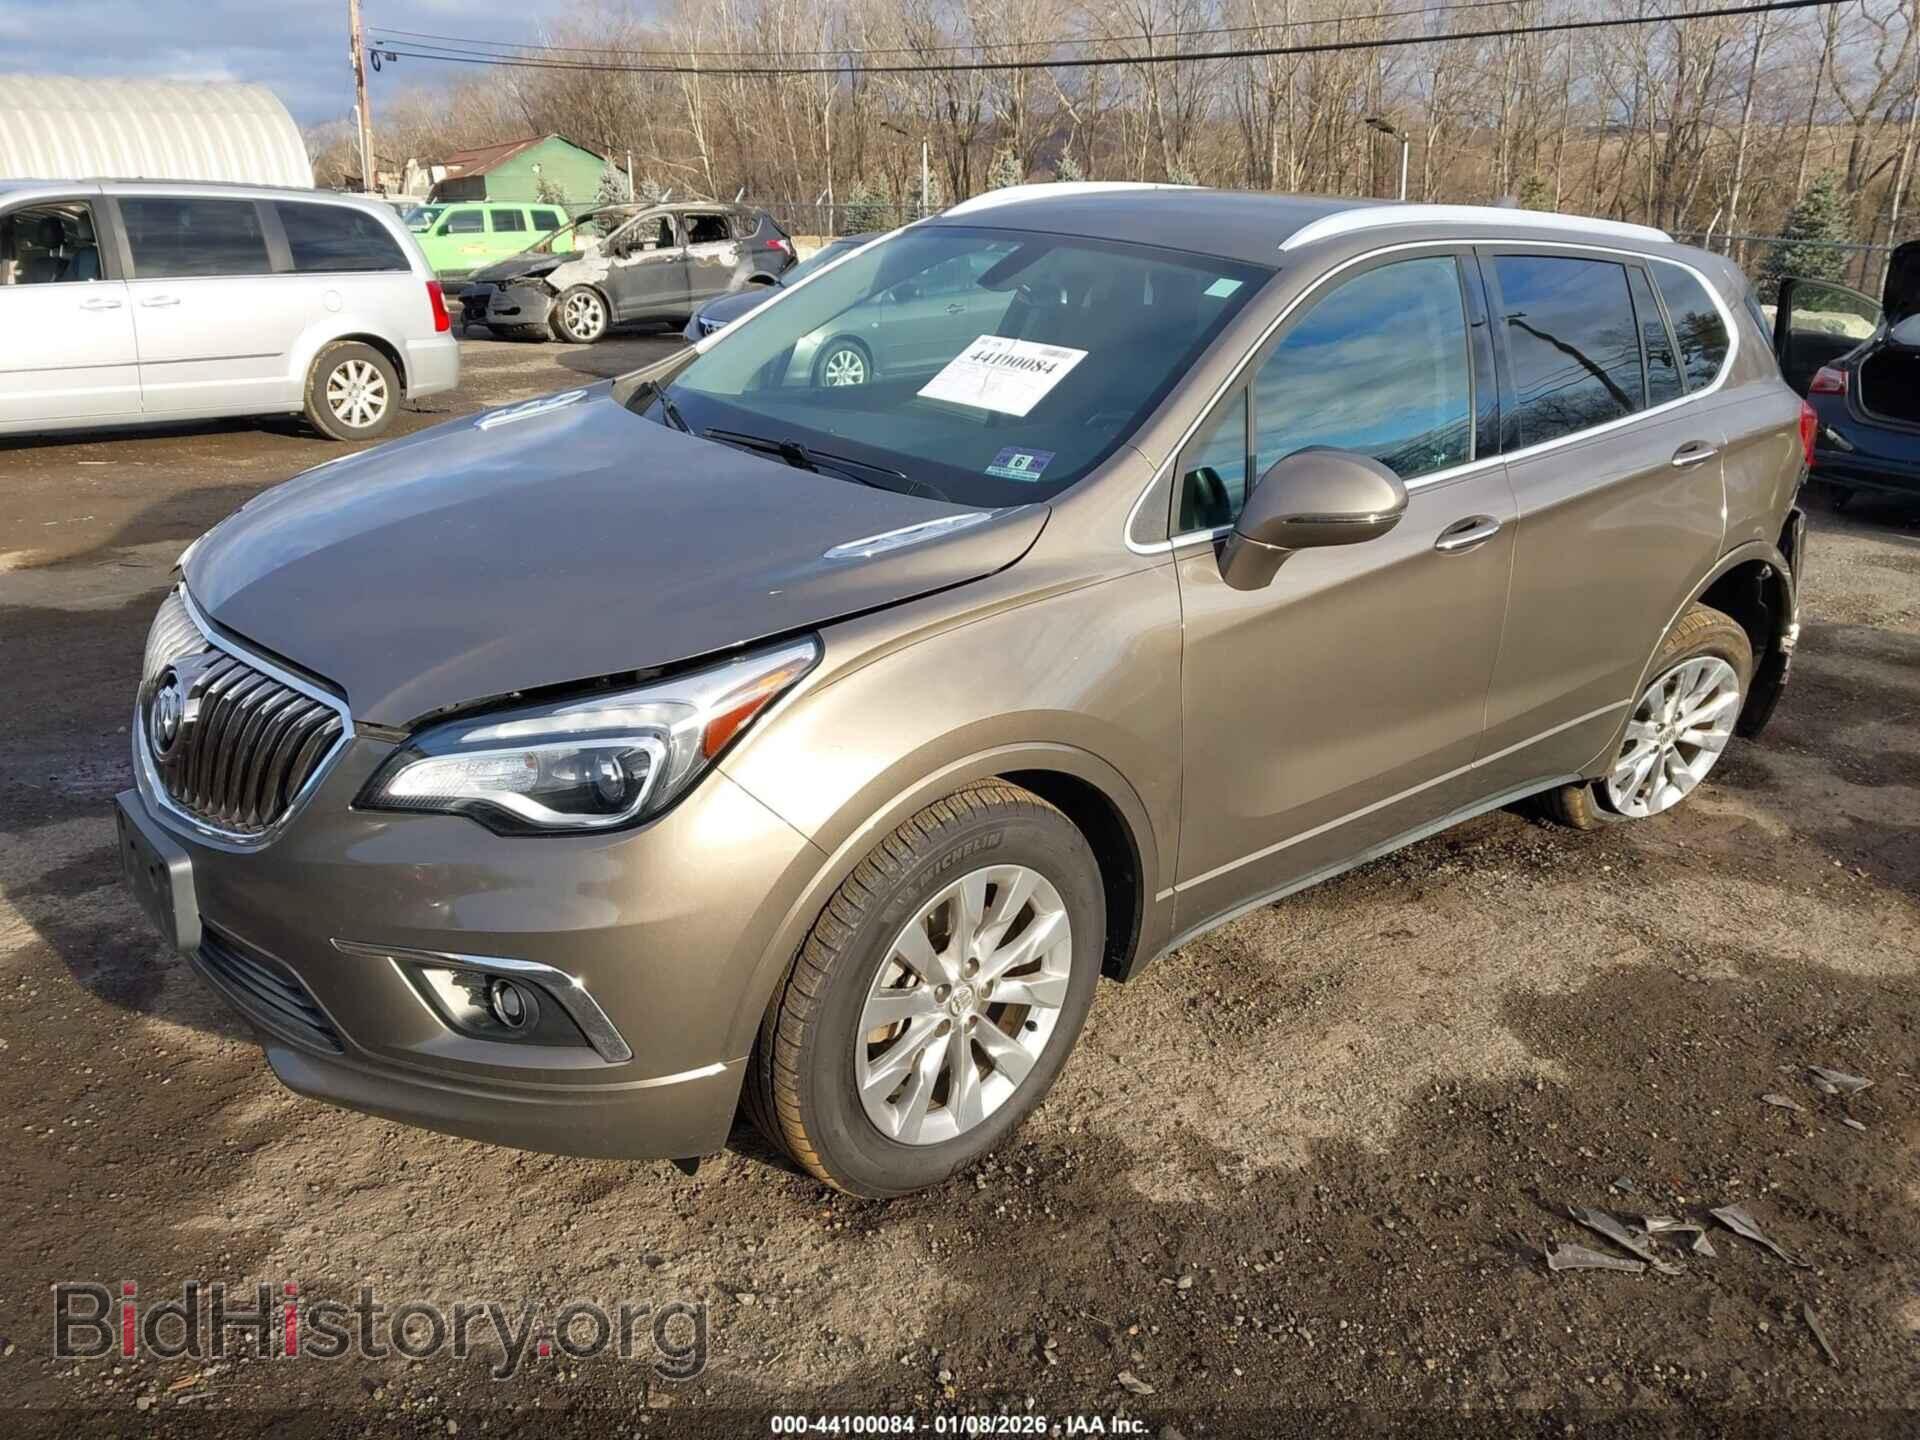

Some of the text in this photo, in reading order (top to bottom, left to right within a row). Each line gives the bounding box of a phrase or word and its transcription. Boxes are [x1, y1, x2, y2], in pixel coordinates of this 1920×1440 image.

[969, 350, 1059, 374] 44100084
[1014, 457, 1025, 467] 6
[920, 831, 1004, 887] MICHELIN
